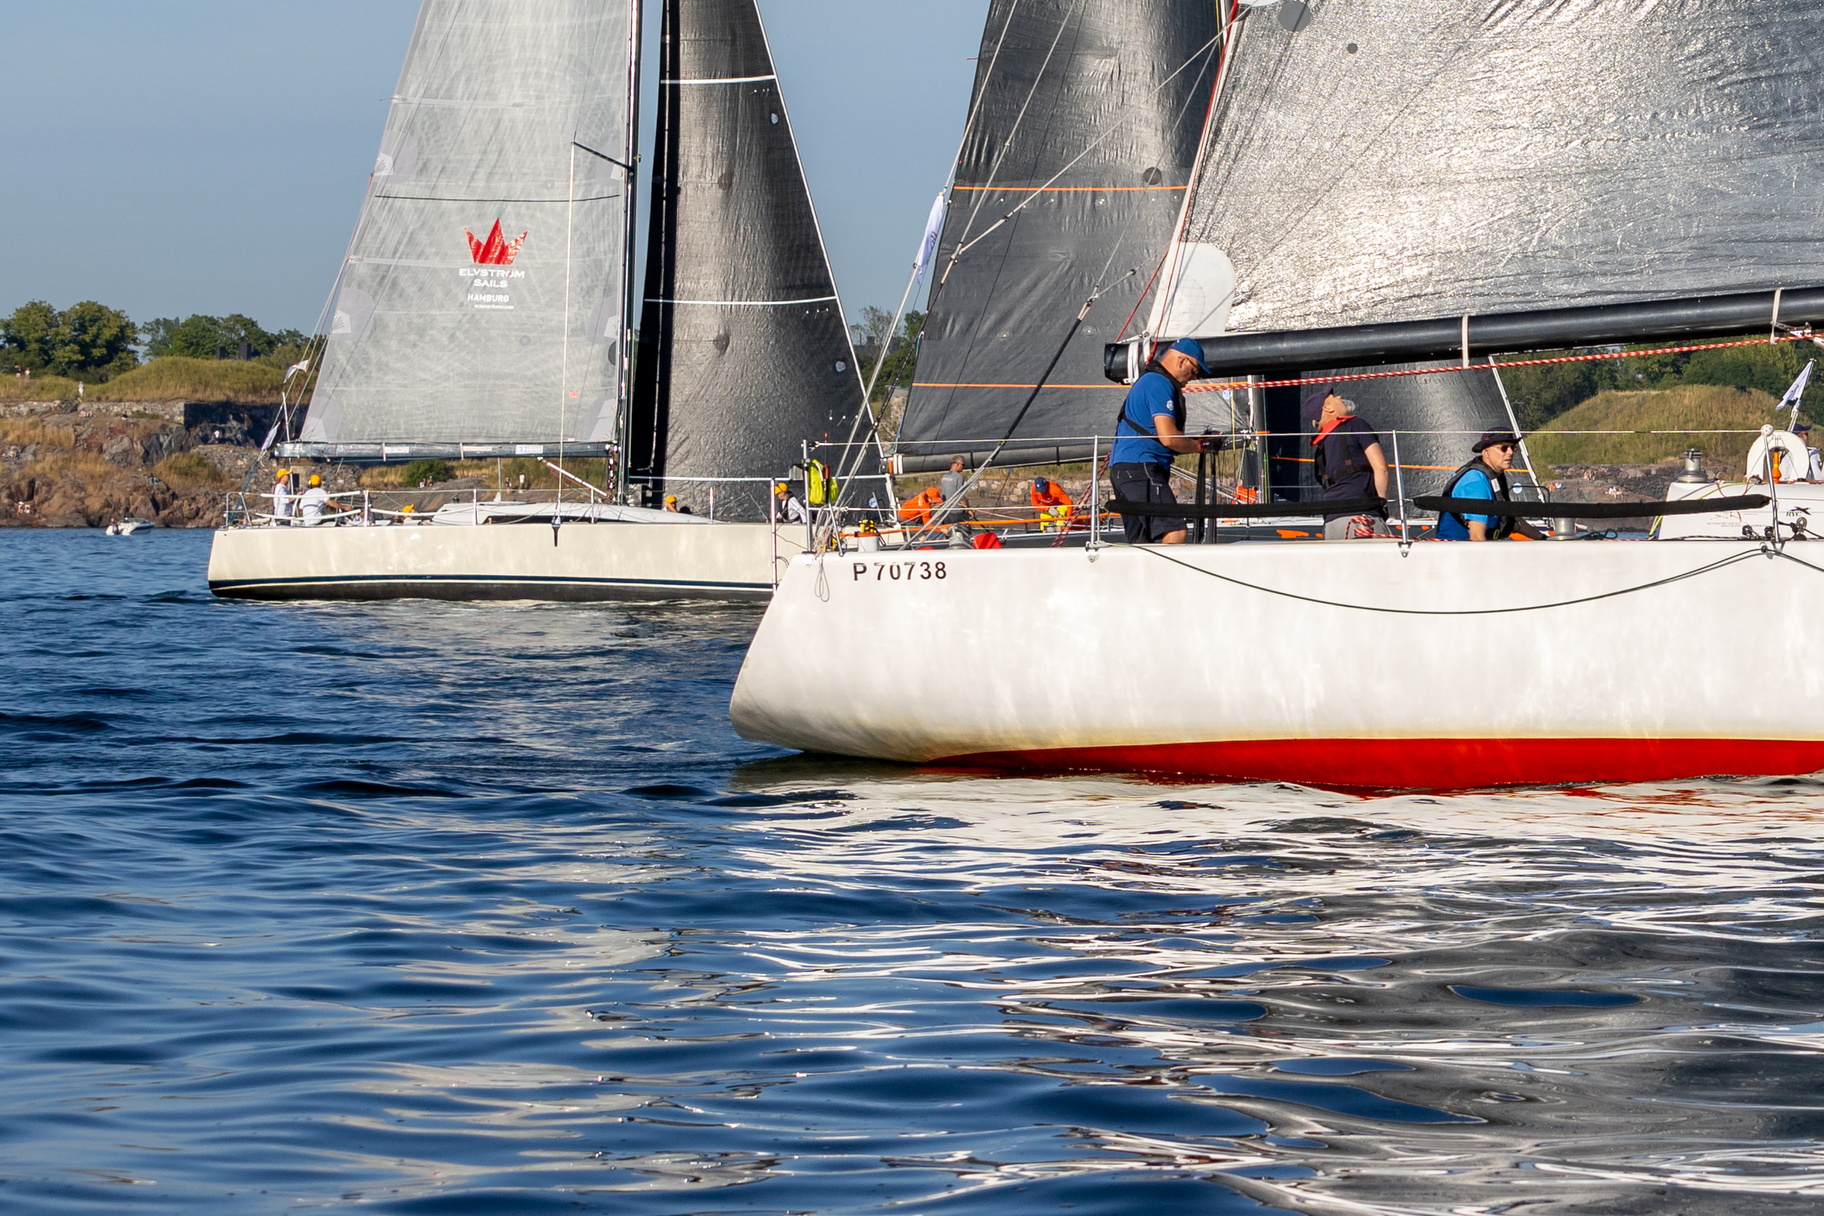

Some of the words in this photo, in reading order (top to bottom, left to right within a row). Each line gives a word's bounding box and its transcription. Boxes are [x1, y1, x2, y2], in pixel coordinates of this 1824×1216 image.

[473, 278, 509, 288] SAILS
[467, 293, 510, 303] HAMBURG
[853, 562, 868, 581] P
[873, 561, 947, 581] 70738
